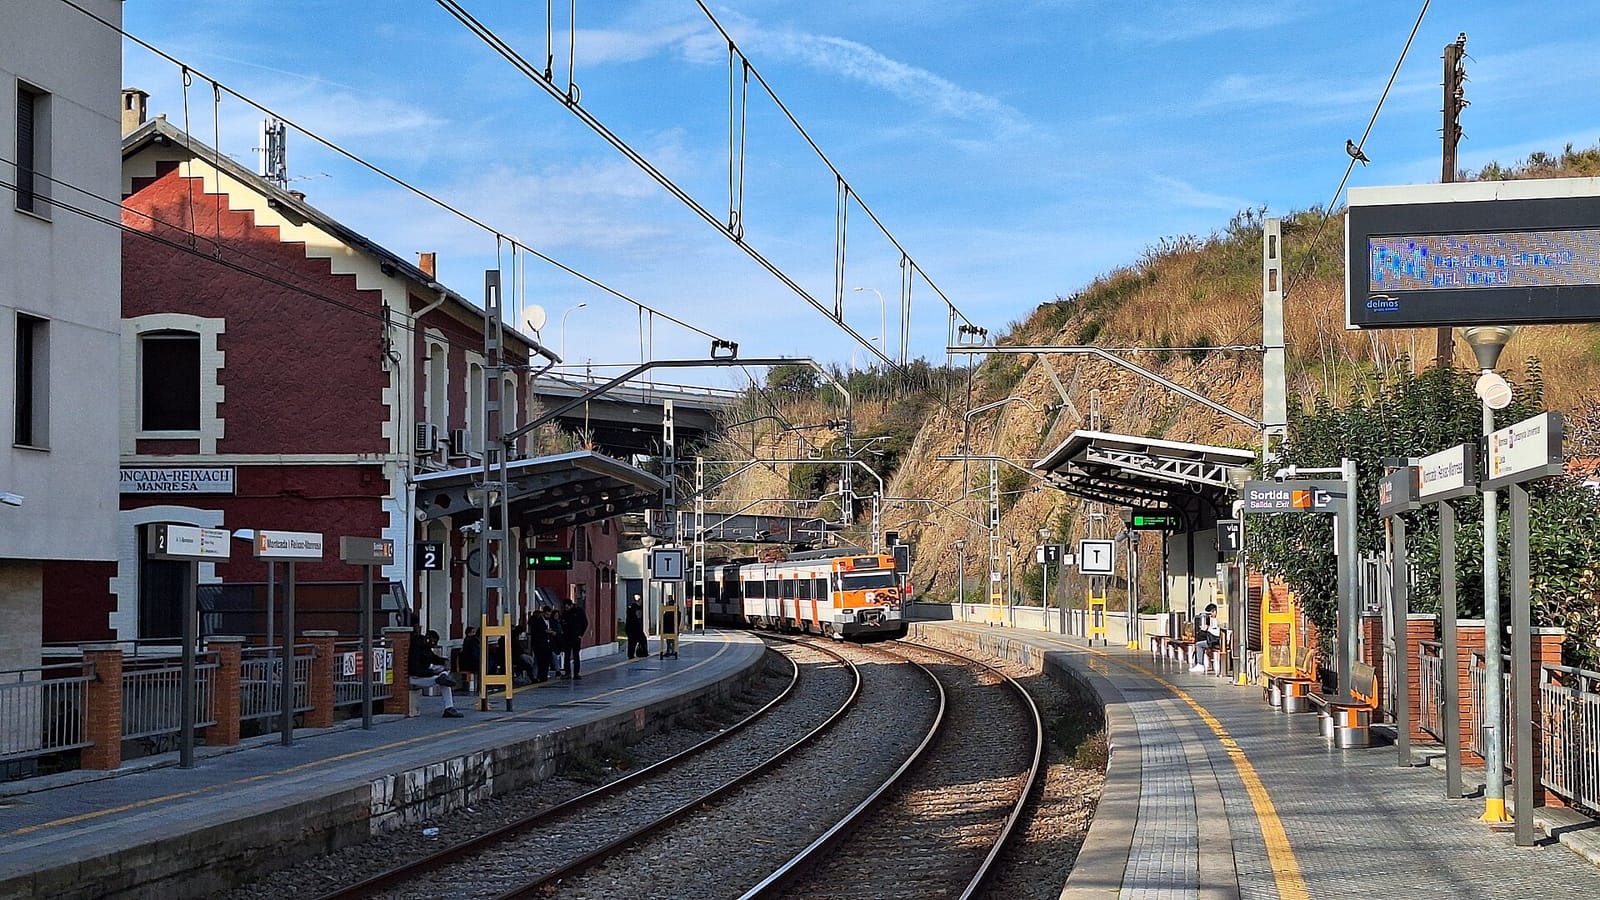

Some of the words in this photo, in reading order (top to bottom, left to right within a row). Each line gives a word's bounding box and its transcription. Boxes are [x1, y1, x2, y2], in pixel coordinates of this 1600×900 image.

[136, 482, 199, 491] MANRESA
[1250, 490, 1290, 500] Sortida
[1250, 501, 1273, 509] Salida
[159, 535, 164, 549] 2
[1227, 532, 1237, 549] 1
[424, 552, 436, 568] 2
[664, 557, 672, 571] T
[1092, 550, 1101, 564] T
